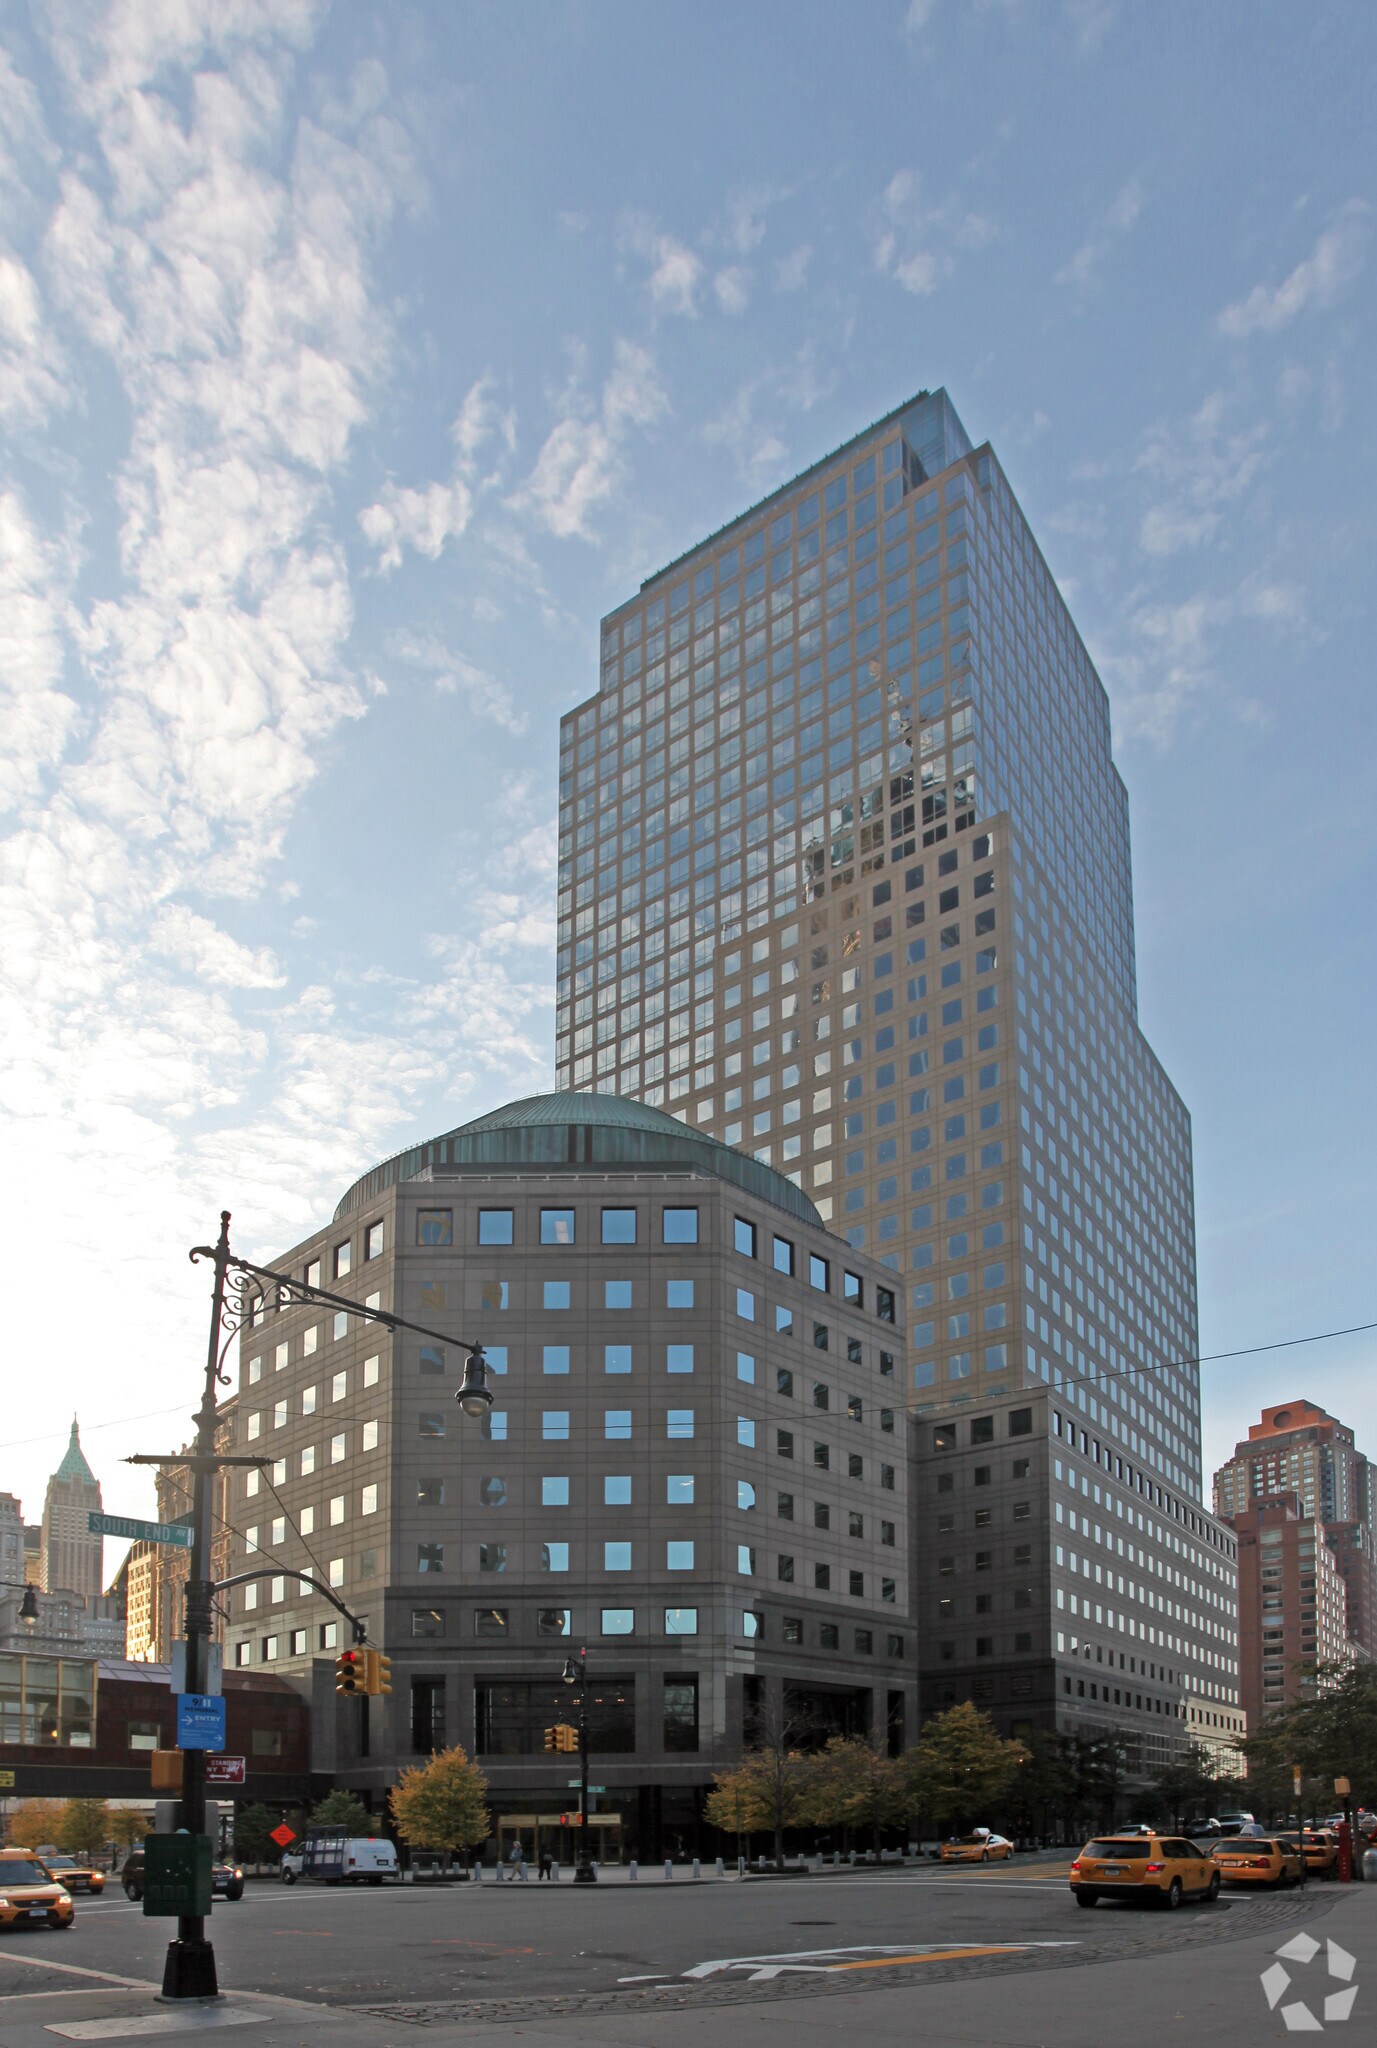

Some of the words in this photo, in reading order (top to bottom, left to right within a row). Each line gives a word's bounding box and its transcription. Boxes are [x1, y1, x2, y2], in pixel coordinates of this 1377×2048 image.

[92, 1516, 137, 1536] SOUTH
[144, 1523, 170, 1541] END
[192, 1698, 211, 1707] 9/11
